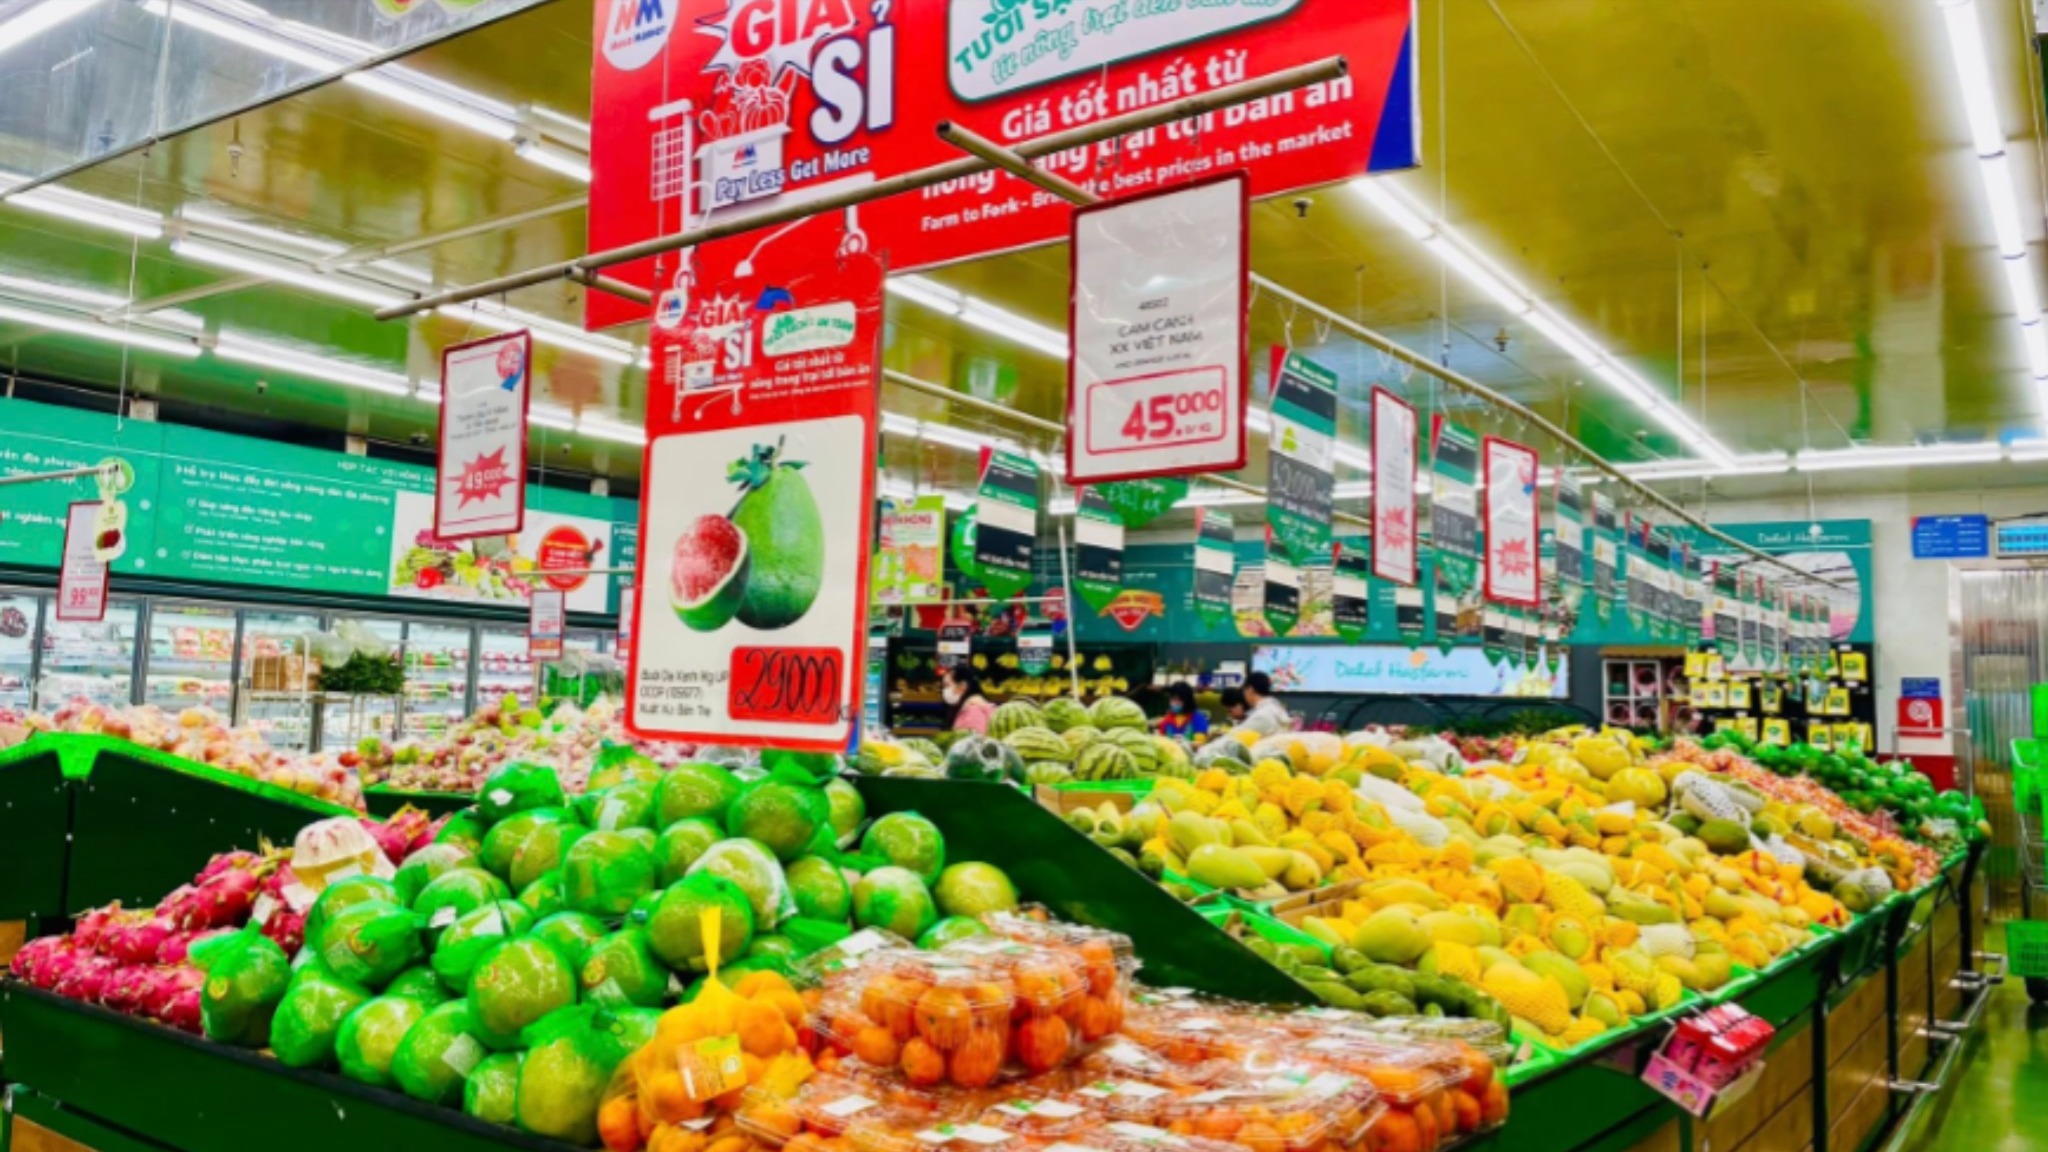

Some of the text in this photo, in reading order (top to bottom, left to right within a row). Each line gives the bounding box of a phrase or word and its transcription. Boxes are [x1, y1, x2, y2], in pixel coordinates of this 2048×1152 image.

[1002, 49, 1248, 139] Giá tốt nhất từ
[715, 147, 871, 202] Pay Less Get More
[921, 213, 960, 232] Farm
[963, 207, 980, 223] to
[981, 196, 1020, 220] Fork
[1113, 167, 1153, 190] best
[1156, 157, 1212, 184] prices
[1215, 147, 1235, 167] in
[1239, 140, 1273, 161] the
[1276, 120, 1352, 153] market
